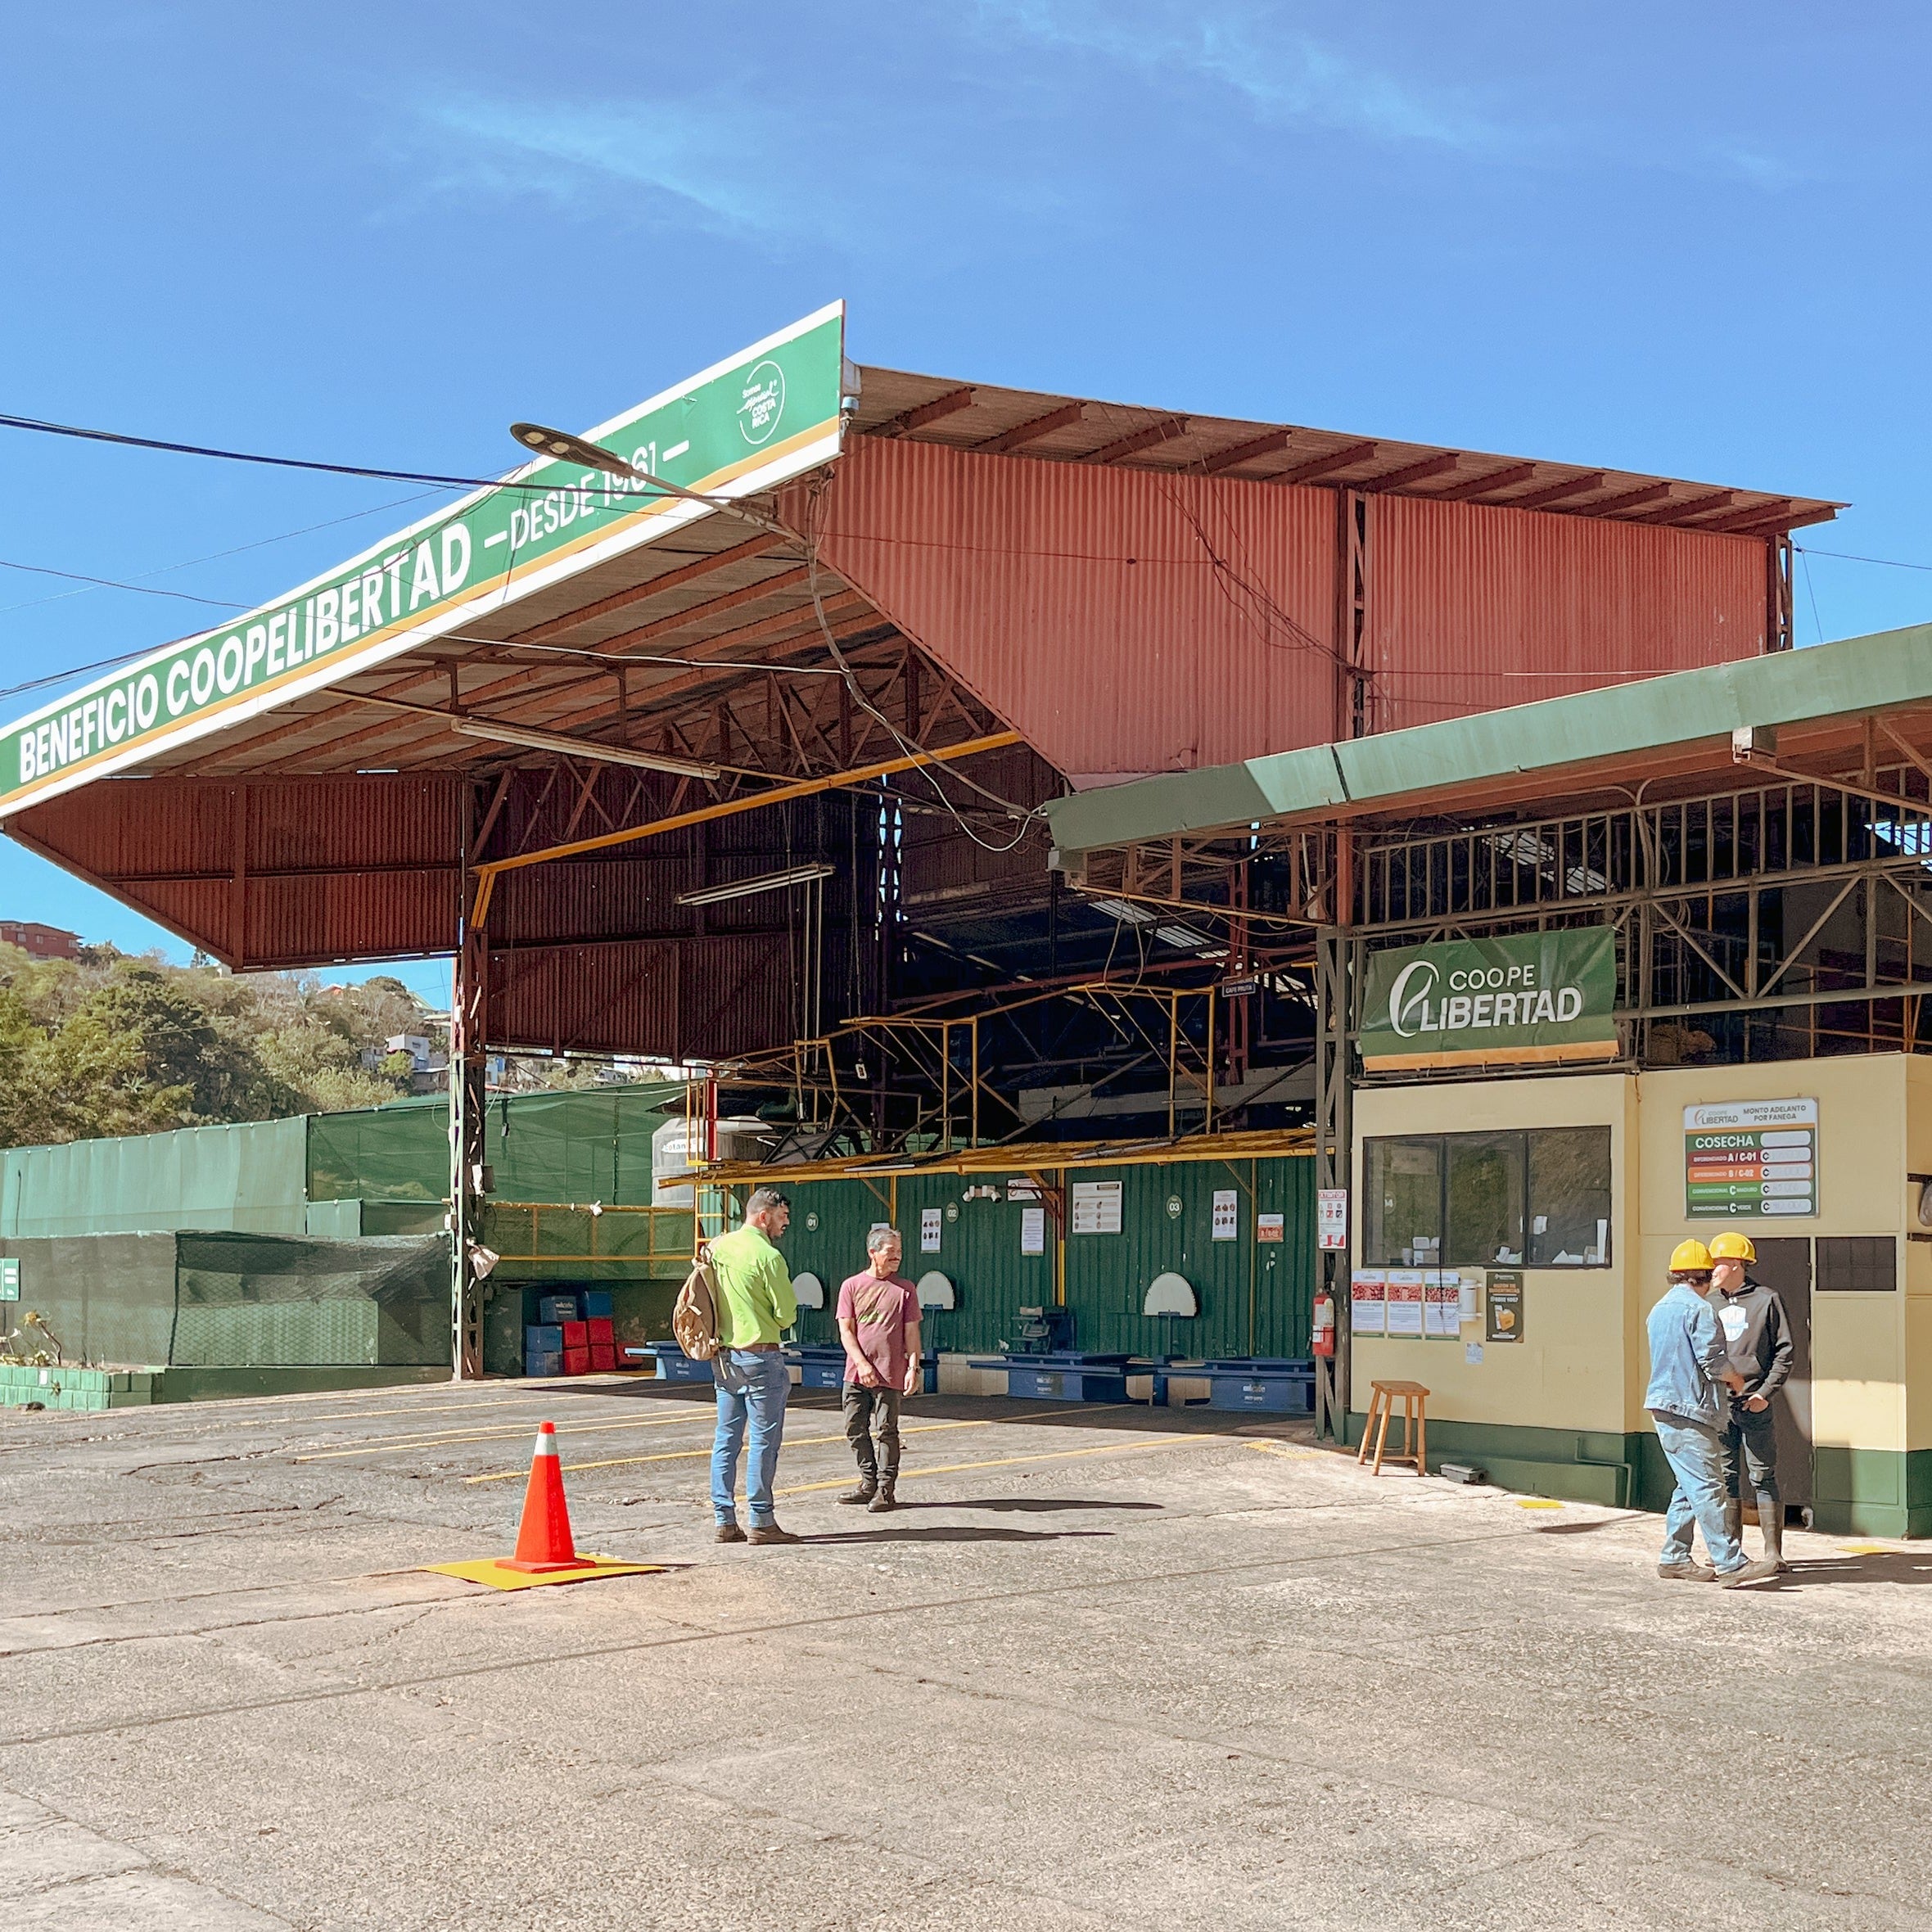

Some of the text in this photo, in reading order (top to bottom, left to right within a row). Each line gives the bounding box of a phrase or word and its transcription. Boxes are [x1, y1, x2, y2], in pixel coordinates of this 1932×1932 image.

[752, 397, 776, 418] COSTA
[752, 412, 770, 429] RICA
[19, 673, 159, 783] BENEFICIO
[166, 522, 472, 717] COOPELIBERTAD
[1449, 964, 1535, 991] COOPE
[1419, 986, 1582, 1031] LIBERTAD
[1769, 1105, 1807, 1113] ADELANTO
[1702, 1116, 1739, 1124] LIBERTAD
[1695, 1135, 1754, 1149] COSECHA
[1727, 1153, 1734, 1162] A
[1739, 1152, 1757, 1162] C-01
[1728, 1169, 1734, 1177] B
[1738, 1169, 1754, 1177] C-02
[1729, 1185, 1736, 1195] C
[1169, 1203, 1180, 1212] 03
[1729, 1203, 1736, 1213] C
[947, 1209, 957, 1217] 02
[807, 1218, 816, 1226] 01
